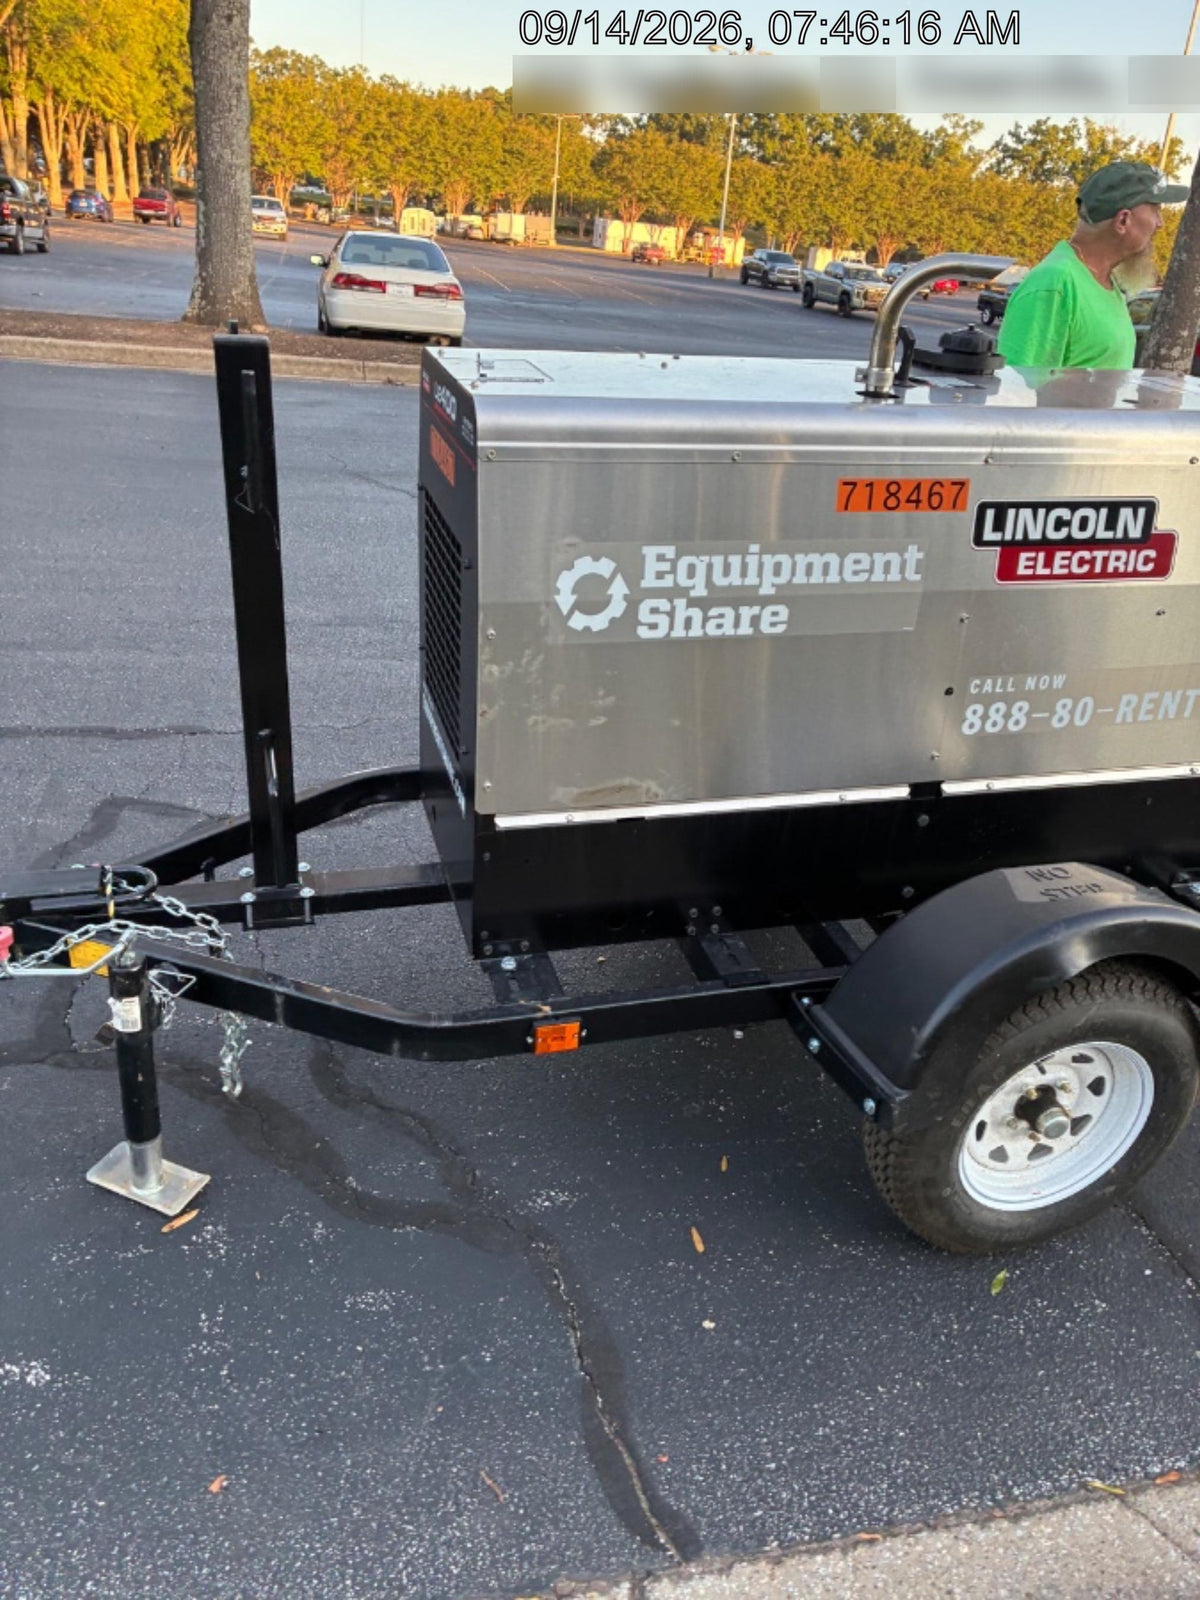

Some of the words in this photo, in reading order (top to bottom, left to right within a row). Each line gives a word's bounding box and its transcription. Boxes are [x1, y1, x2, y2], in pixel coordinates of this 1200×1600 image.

[841, 480, 966, 511] 718467
[982, 506, 1147, 541] LINCOLN
[640, 543, 924, 596] Equipment
[1016, 548, 1157, 576] ELECTRIC
[636, 598, 789, 639] Share
[970, 677, 1016, 694] CALL
[1025, 674, 1066, 691] NOW
[1025, 867, 1072, 882] NO
